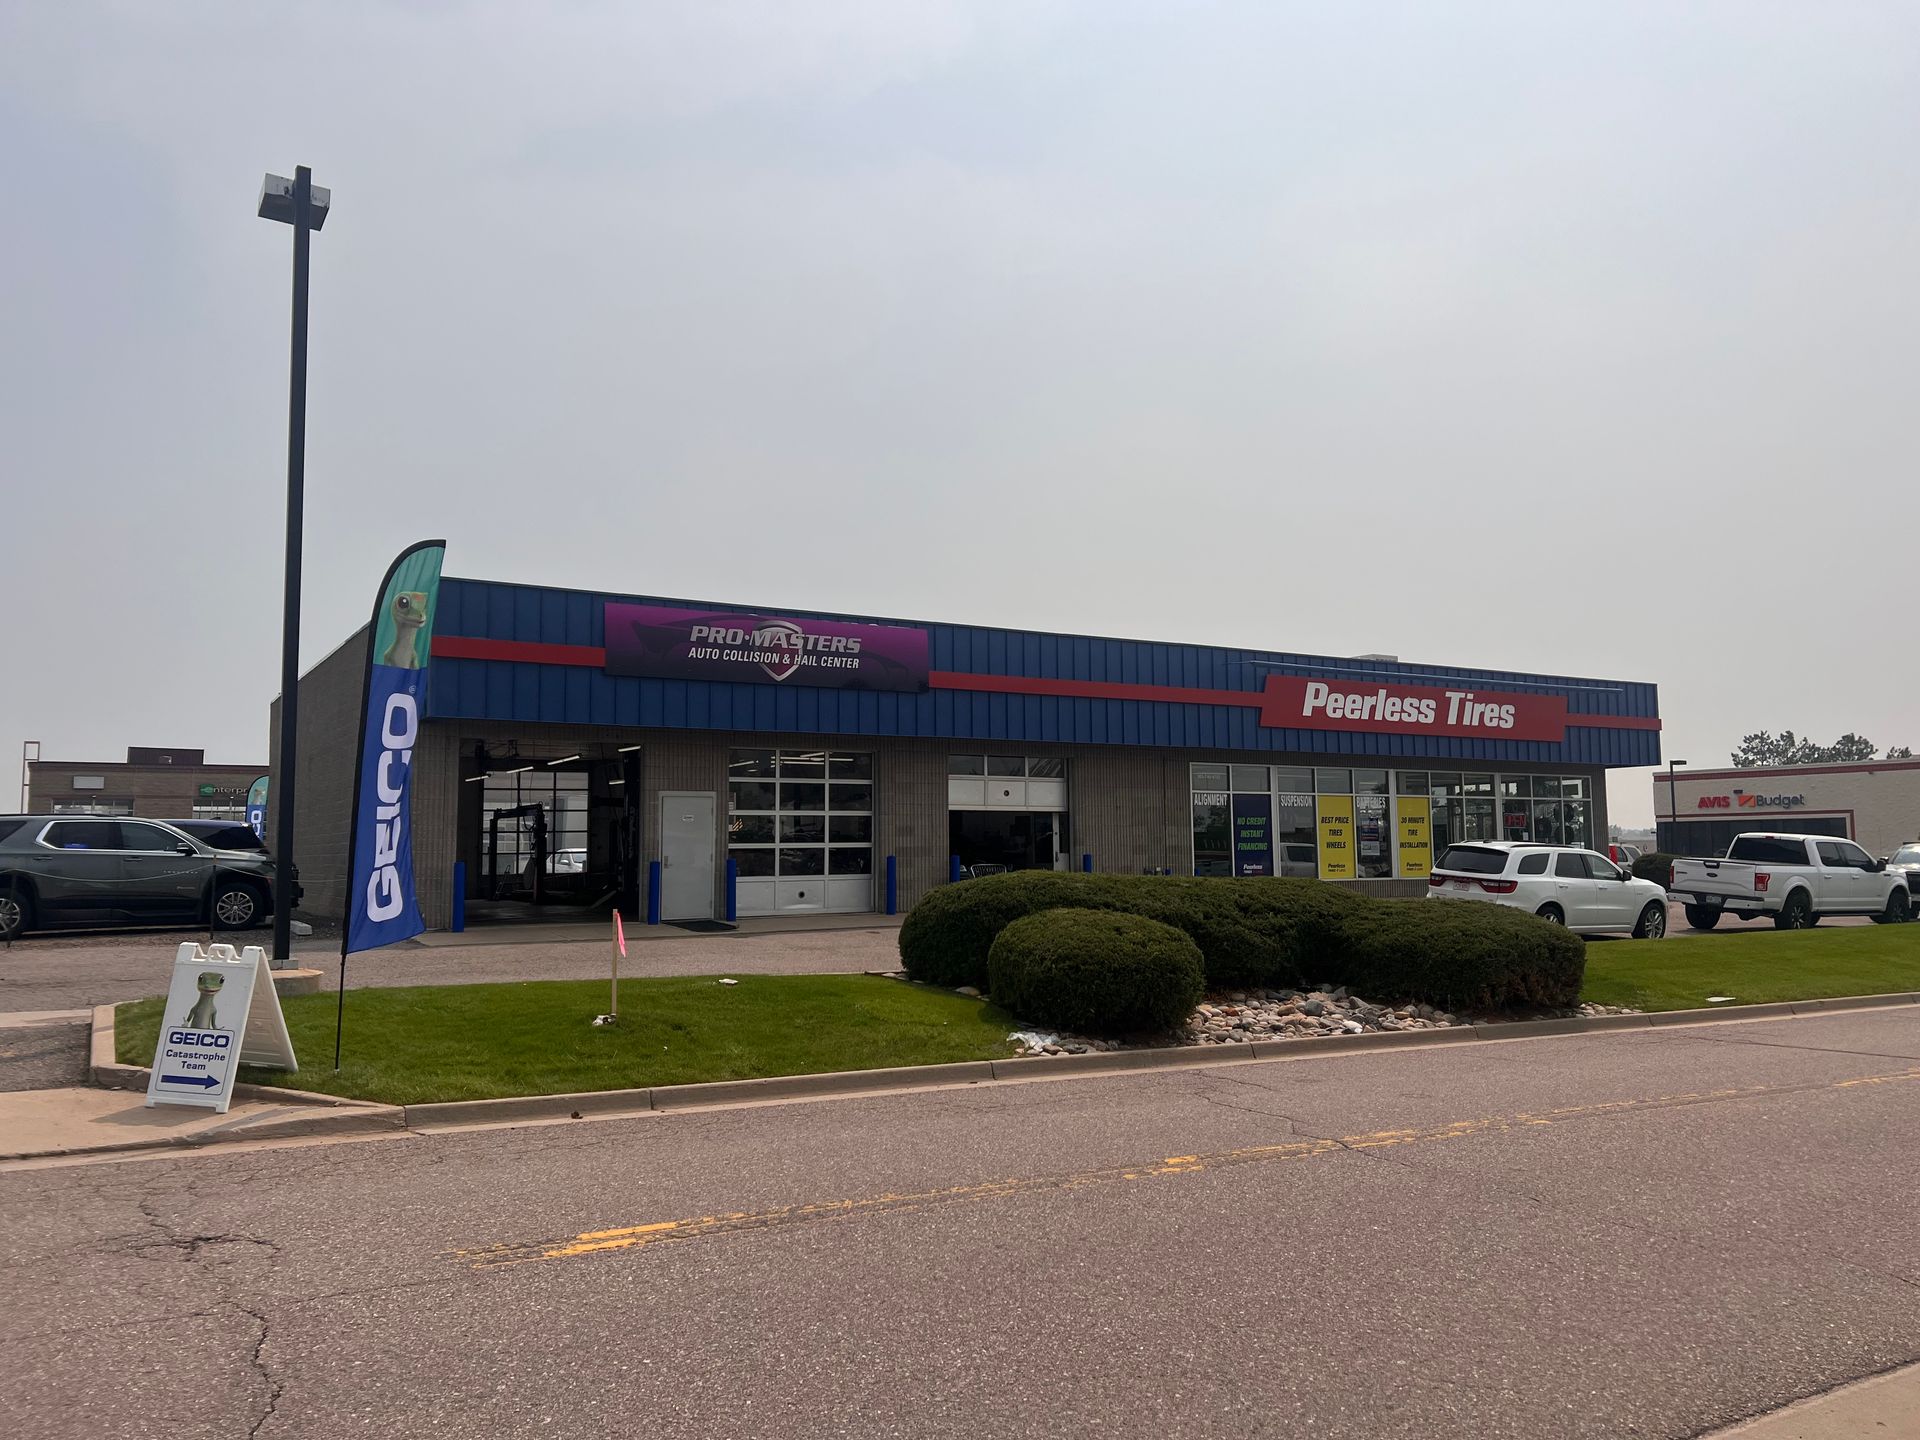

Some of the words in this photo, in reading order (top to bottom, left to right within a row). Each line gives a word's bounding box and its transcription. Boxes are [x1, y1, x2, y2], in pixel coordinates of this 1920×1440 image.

[688, 647, 720, 660] AUTO
[723, 649, 780, 665] COLLISION
[782, 653, 792, 665] &
[794, 654, 818, 667] HAIL
[821, 656, 860, 670] CENTER
[1302, 682, 1436, 725] Peerless
[1445, 691, 1515, 729] Tires
[1194, 794, 1228, 806] ALIGNMENT
[1280, 795, 1313, 807] SUSPENSION
[1697, 796, 1731, 809] AVIS
[1756, 794, 1805, 810] Budget
[367, 692, 418, 922] GEICO
[1237, 817, 1246, 825] NO
[1247, 817, 1266, 825] CREDIT
[1321, 816, 1334, 824] BEST
[1335, 816, 1350, 824] PRICE
[1504, 815, 1526, 828] OPEN
[1240, 830, 1264, 838] INSTANT
[1237, 842, 1268, 851] FINANCING
[1326, 841, 1347, 849] WHEELS
[1400, 841, 1429, 849] INSTALLATION
[169, 1031, 230, 1048] GEICO
[166, 1049, 226, 1062] Catastrophe
[181, 1060, 206, 1071] Team
